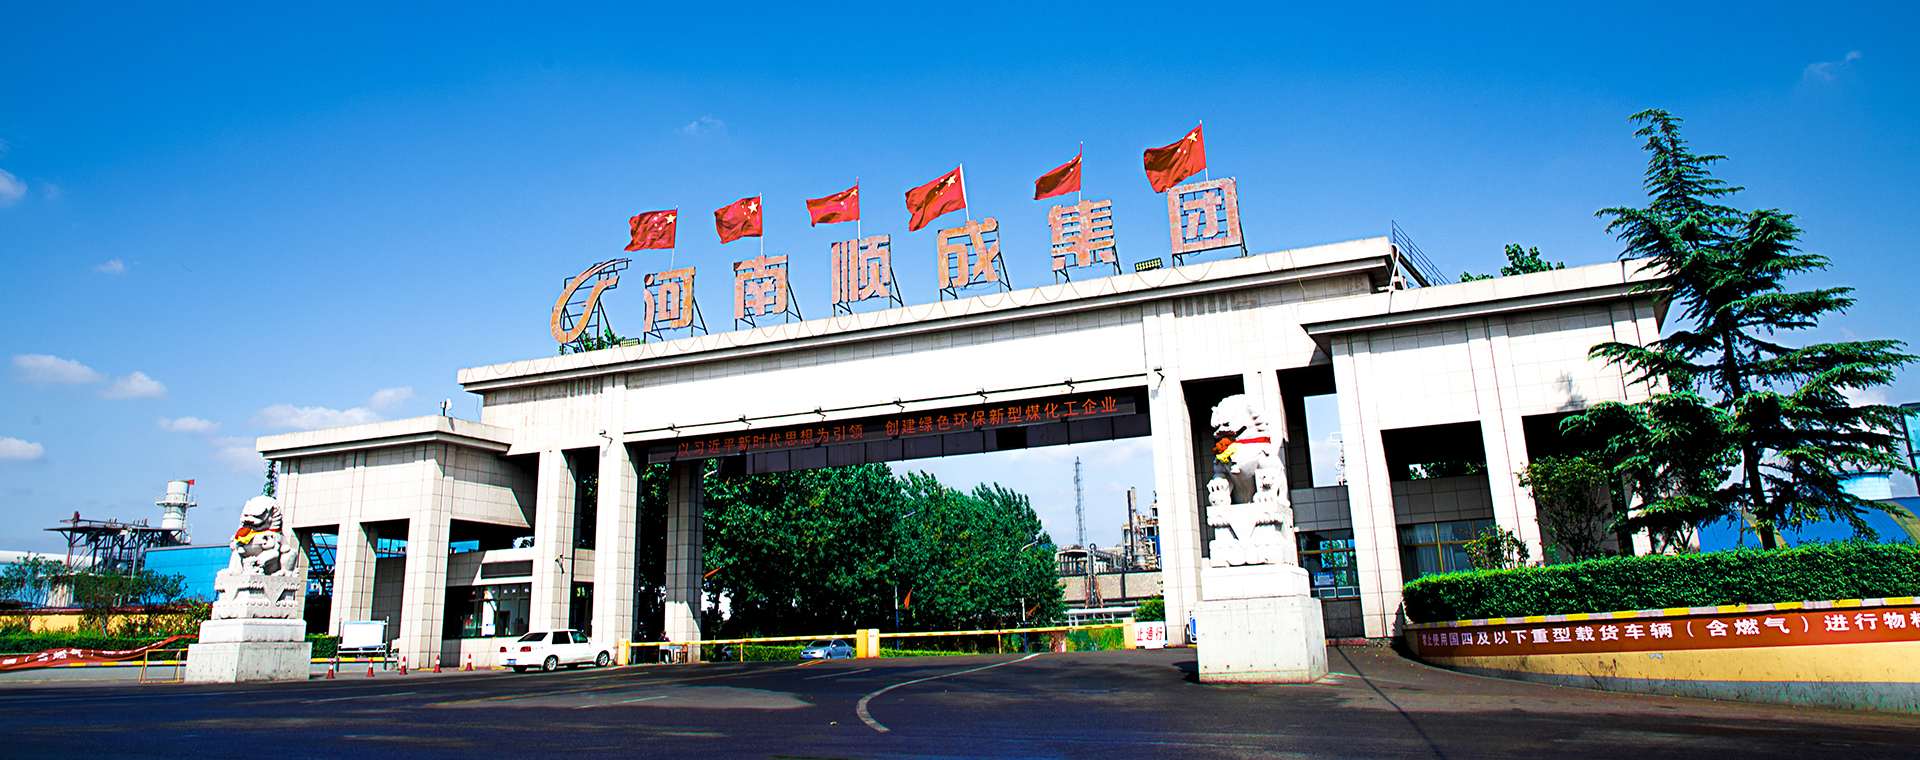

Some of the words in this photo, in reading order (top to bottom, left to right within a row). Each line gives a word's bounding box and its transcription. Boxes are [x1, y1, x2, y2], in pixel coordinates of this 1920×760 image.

[643, 177, 1241, 332] 河南顺成集团
[678, 424, 863, 457] 以习近平新时代思想为引领
[885, 396, 1118, 436] 创建绿色环保新型煤化工企业
